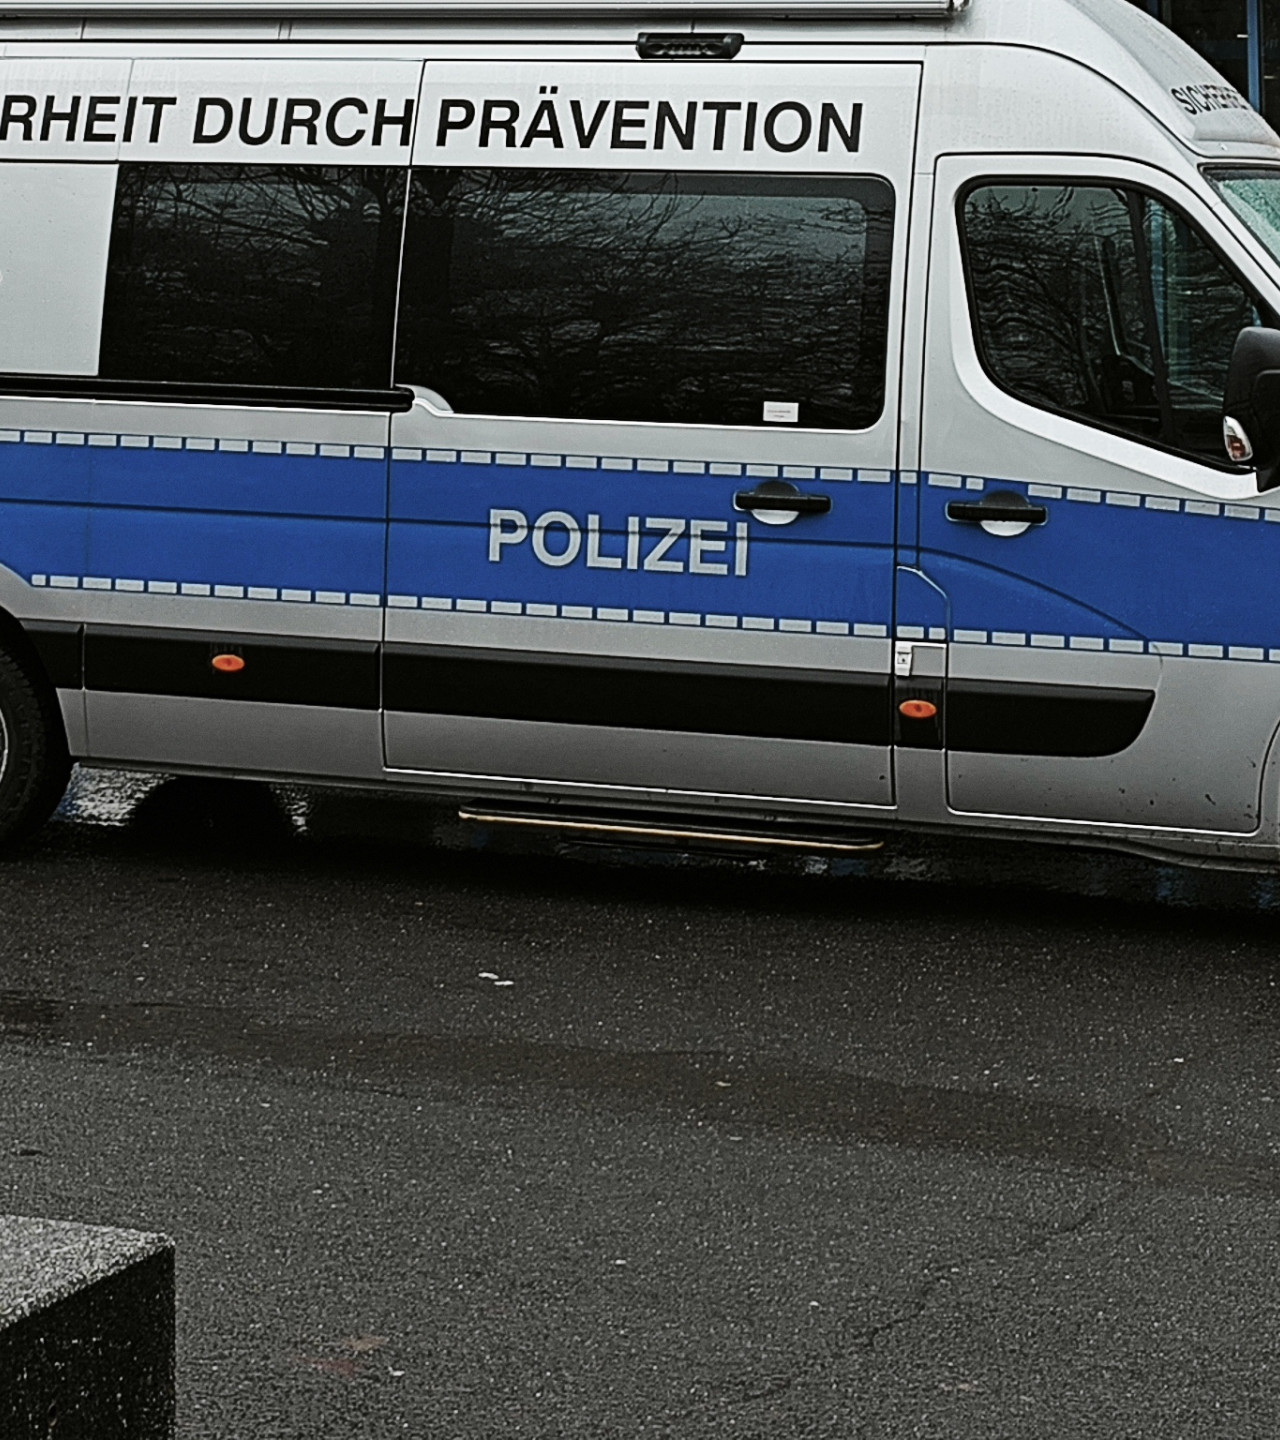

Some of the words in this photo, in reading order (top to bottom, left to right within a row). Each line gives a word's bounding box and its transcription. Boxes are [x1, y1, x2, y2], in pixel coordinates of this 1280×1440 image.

[192, 97, 415, 147] DURCH
[435, 85, 863, 153] PRÄVENTION
[488, 508, 748, 576] POLIZEI
